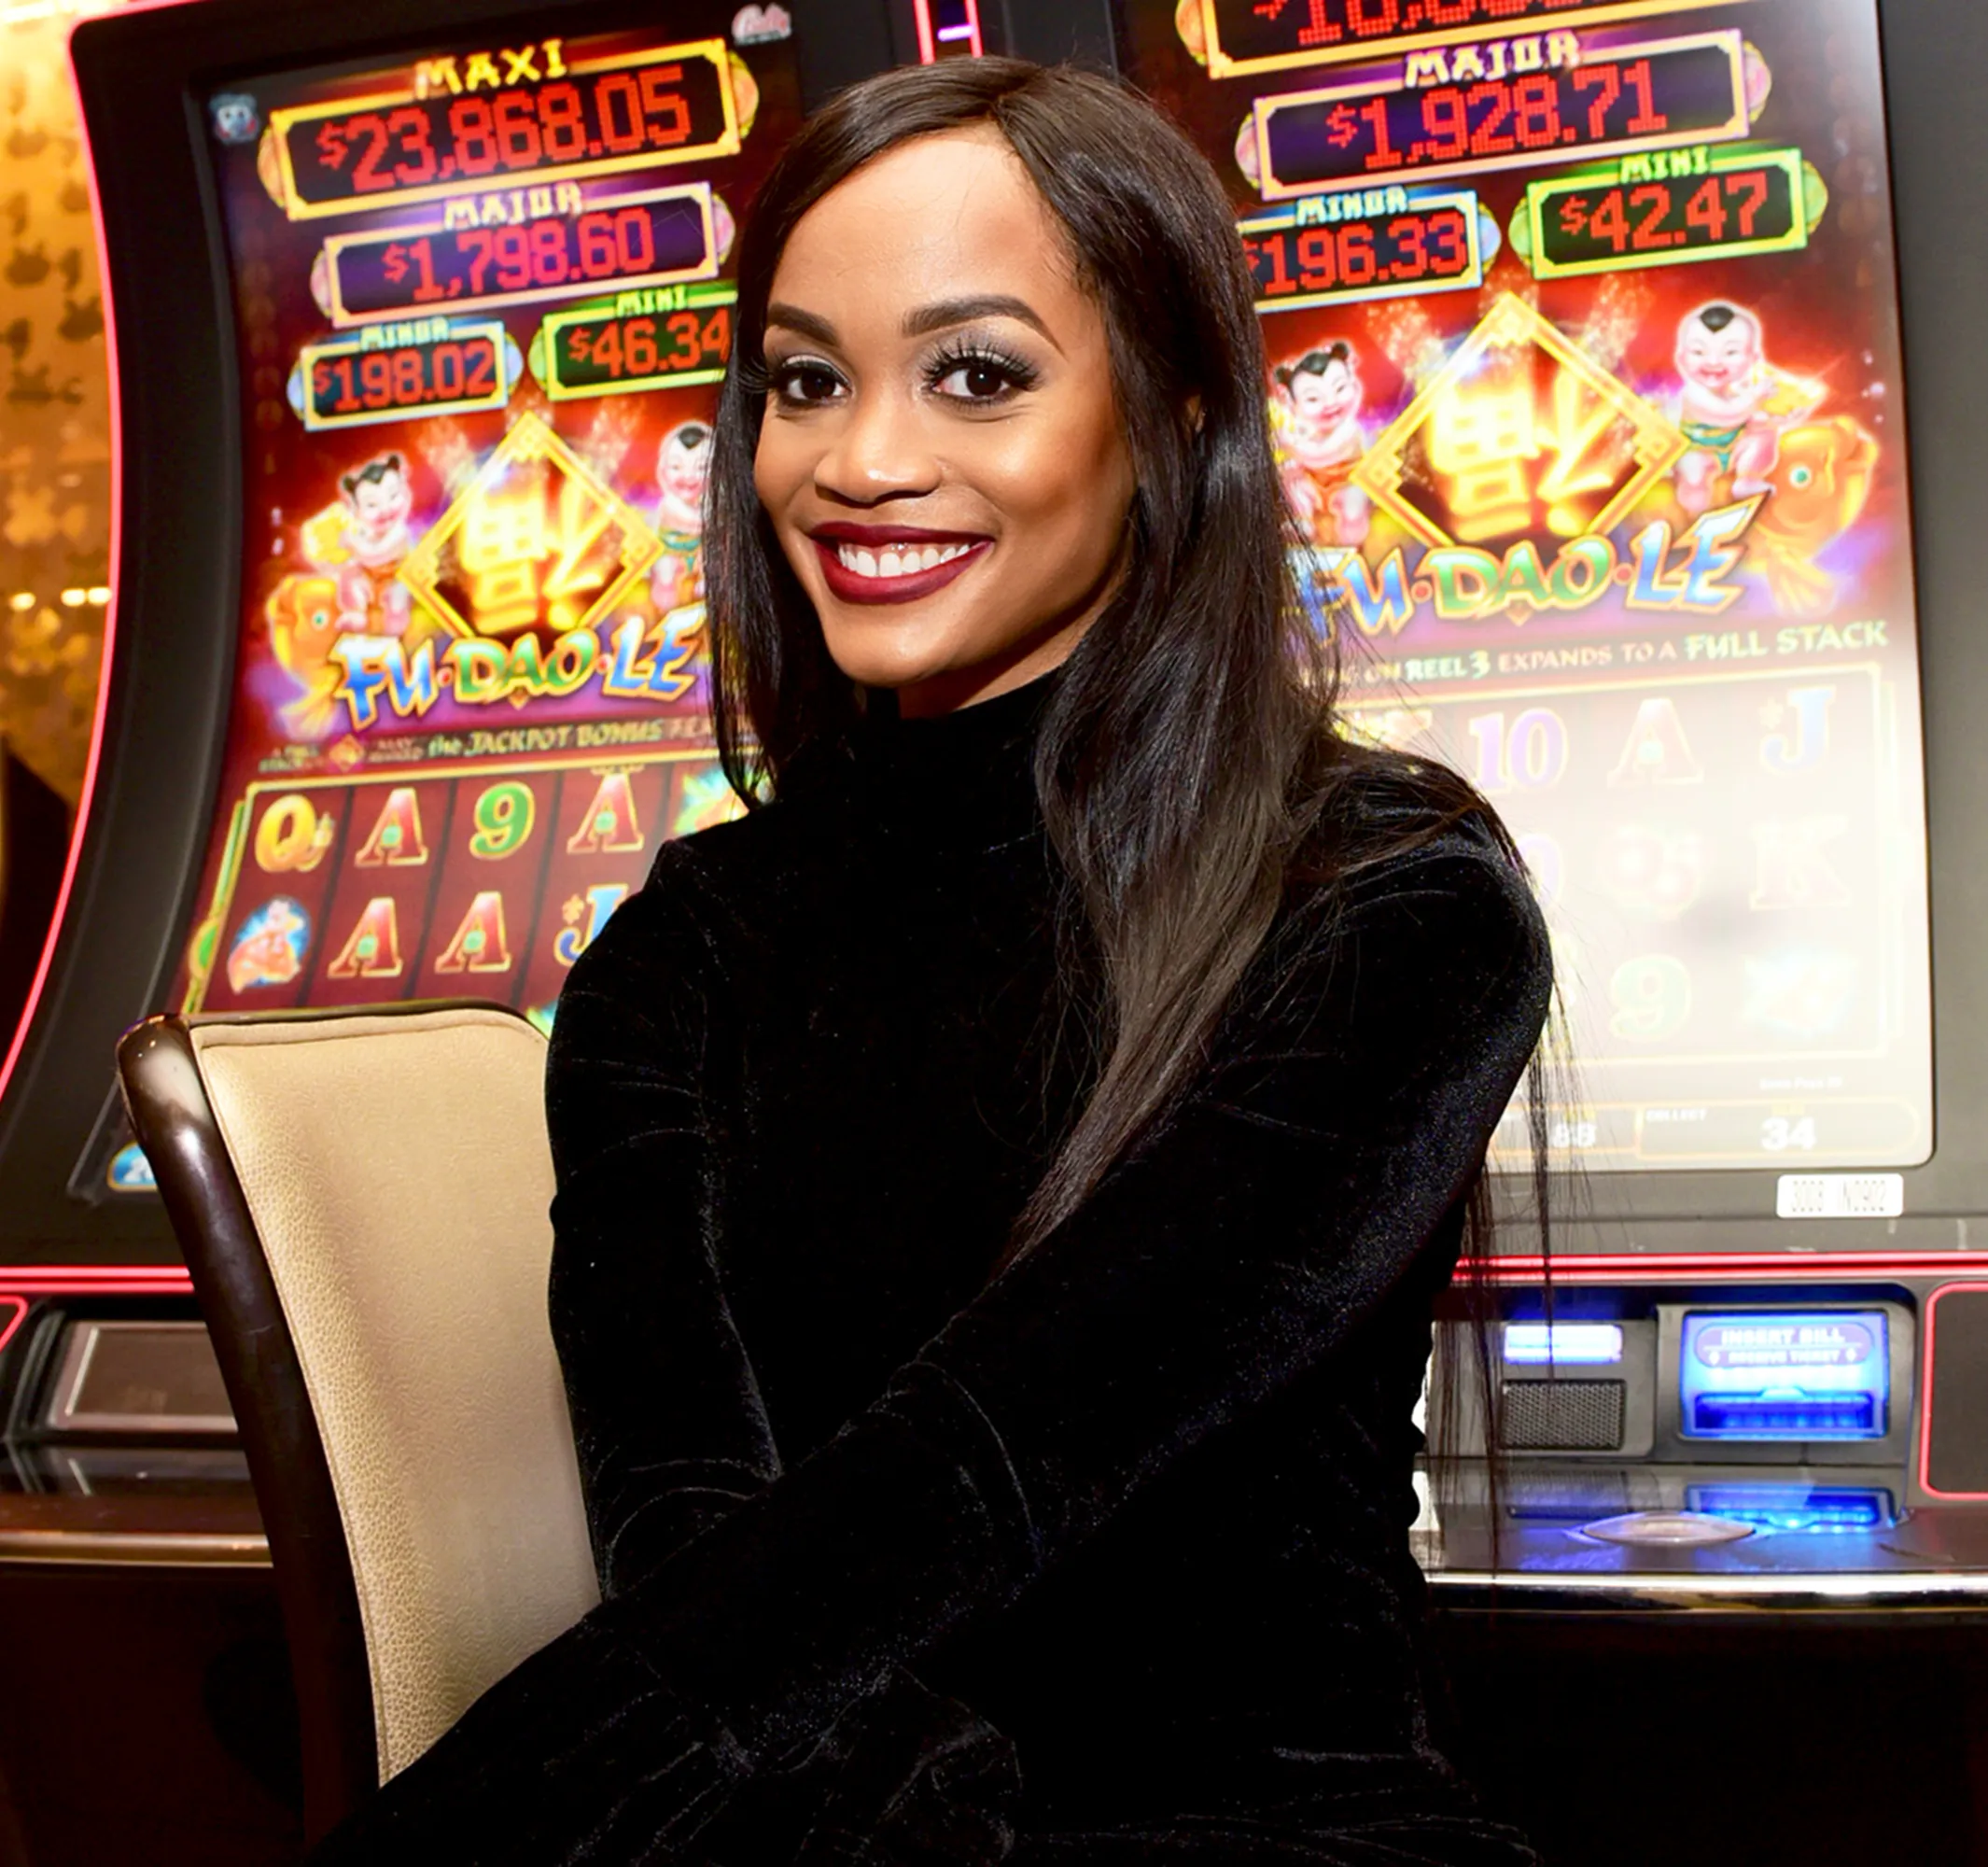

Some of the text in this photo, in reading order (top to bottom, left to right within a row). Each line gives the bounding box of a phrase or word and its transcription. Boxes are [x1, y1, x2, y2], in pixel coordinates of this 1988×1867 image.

[414, 38, 567, 99] MAXI
[1405, 29, 1578, 88] MAJOR
[315, 67, 692, 193] $23,868.05
[1326, 60, 1666, 168] $1,928.71
[1621, 147, 1709, 182] MINI
[443, 181, 582, 230] MAJOR
[1296, 188, 1408, 225] MINOR
[1560, 172, 1768, 251] $42.47
[382, 207, 654, 302] $1,798.60
[616, 285, 688, 317] MINI
[360, 318, 450, 348] MINOR
[567, 310, 730, 377] $46.34
[312, 342, 496, 415] $198.02
[1406, 657, 1465, 681] REEL
[1470, 652, 1491, 680] 3
[1498, 644, 1611, 673] EXPANDS
[1621, 641, 1654, 663] TO
[1658, 640, 1676, 659] A
[1685, 631, 1766, 659] FULL
[1776, 619, 1888, 652] STACK
[463, 725, 572, 758] JACKPOT
[578, 717, 663, 747] BONUS
[1469, 707, 1568, 793] 10
[355, 788, 428, 868] A
[469, 781, 536, 860] 9
[567, 772, 645, 854] A
[327, 897, 404, 979] A
[435, 891, 511, 974] A
[1761, 1116, 1816, 1150] 34
